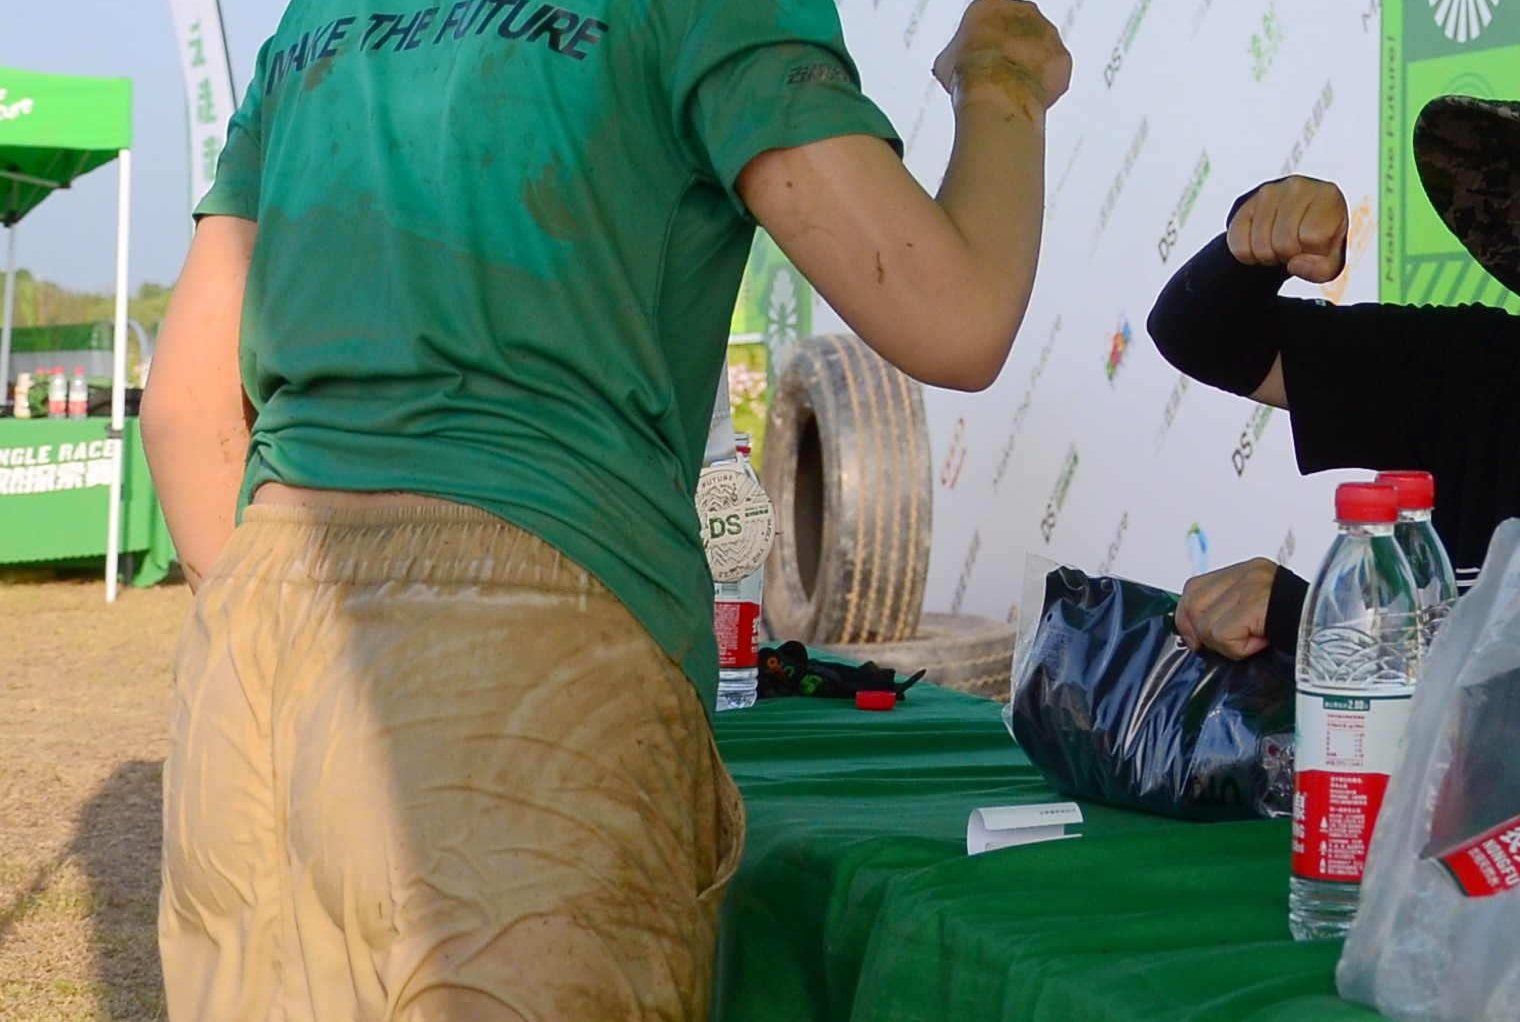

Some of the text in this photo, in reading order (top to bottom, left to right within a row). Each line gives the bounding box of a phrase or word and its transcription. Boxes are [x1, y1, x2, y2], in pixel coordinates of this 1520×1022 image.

[265, 16, 357, 95] MAKE
[360, 7, 440, 53] THE
[1231, 428, 1254, 477] DS
[709, 514, 743, 539] DS
[1482, 838, 1520, 886] NONGFU
